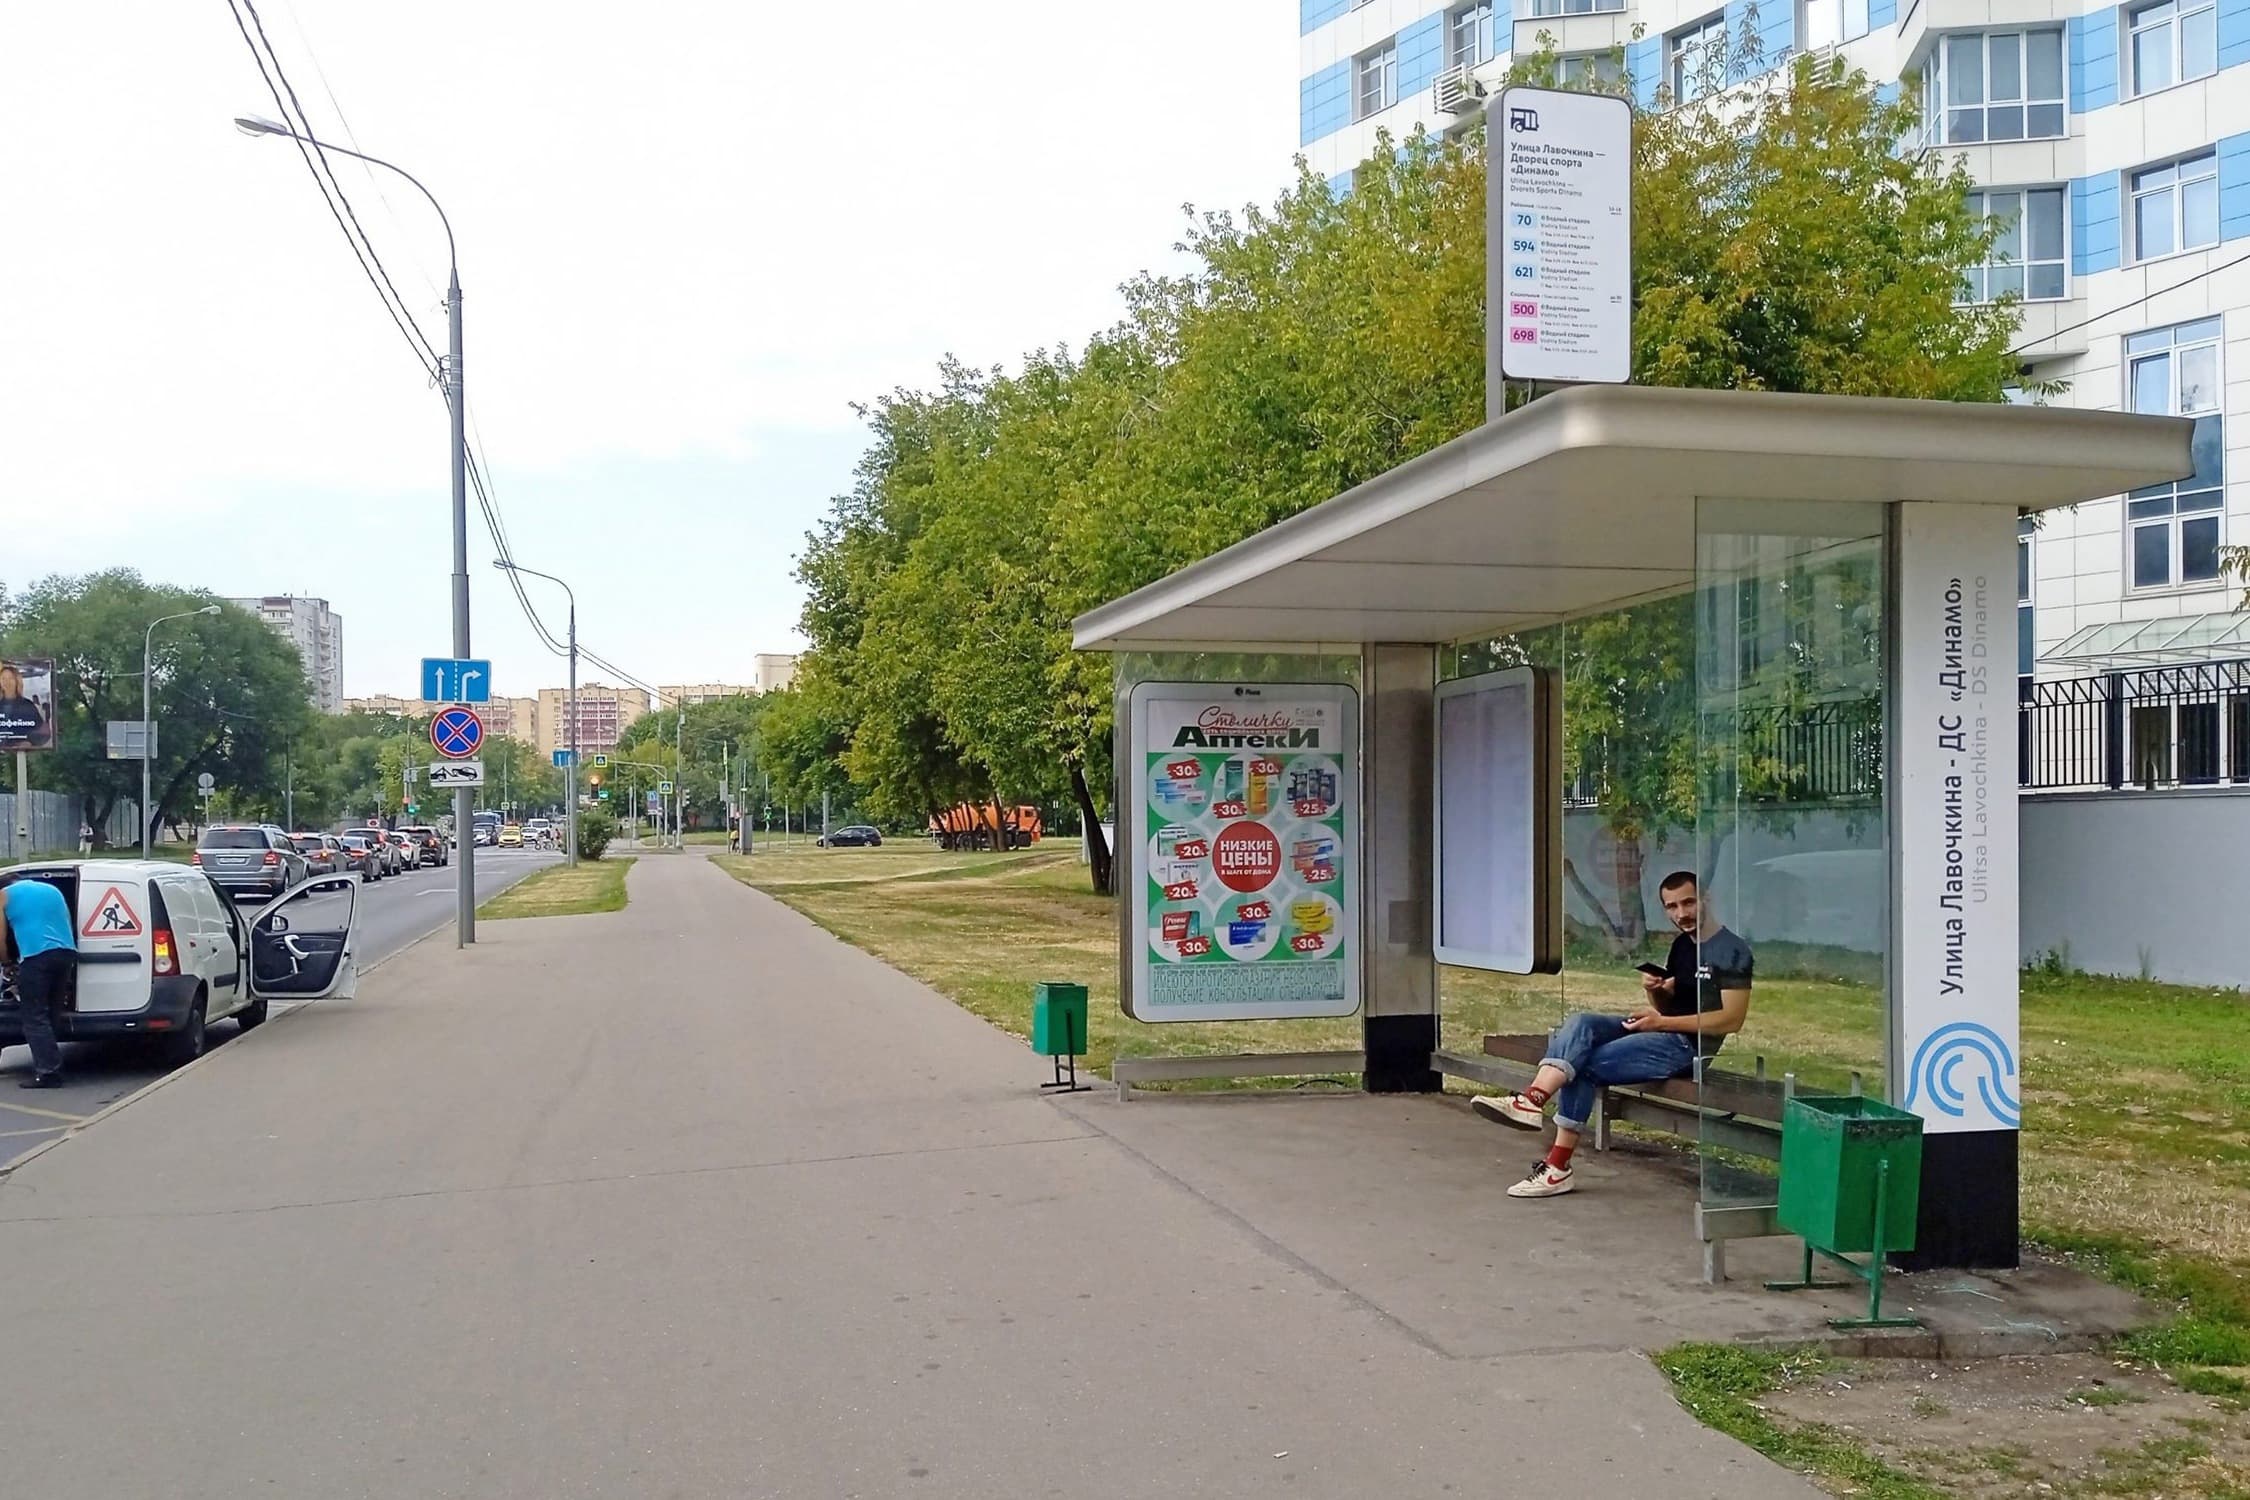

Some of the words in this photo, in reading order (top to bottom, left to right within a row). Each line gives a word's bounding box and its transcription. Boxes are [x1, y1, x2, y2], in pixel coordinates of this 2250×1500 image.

[1510, 142, 1540, 153] Улица
[1543, 144, 1594, 158] Лавочкина
[1510, 153, 1548, 165] Дворец
[1550, 159, 1583, 168] спорта
[1510, 164, 1560, 177] «Динамо»
[1530, 178, 1566, 187] Lavochkina
[1517, 214, 1532, 226] 70
[1513, 240, 1535, 252] 594
[1515, 266, 1533, 278] 621
[1513, 304, 1535, 316] 500
[1513, 330, 1534, 341] 698
[1972, 576, 1987, 658] Dinamo
[1939, 577, 1966, 702] «Динамо»
[1972, 666, 1987, 695] DS
[0, 718, 35, 728] офейню
[1198, 705, 1295, 728] Столички
[1939, 715, 1966, 752] ДС
[1971, 717, 1987, 837] Lavochkina
[1220, 840, 1273, 851] НИЗКИЕ
[1940, 775, 1963, 912] Лавочкина
[1221, 851, 1273, 868] ЦЕНЫ
[1972, 845, 1987, 903] Ulitsa
[1940, 919, 1966, 995] Улица
[1154, 987, 1204, 1003] ПОЛУЧЕНИЕ
